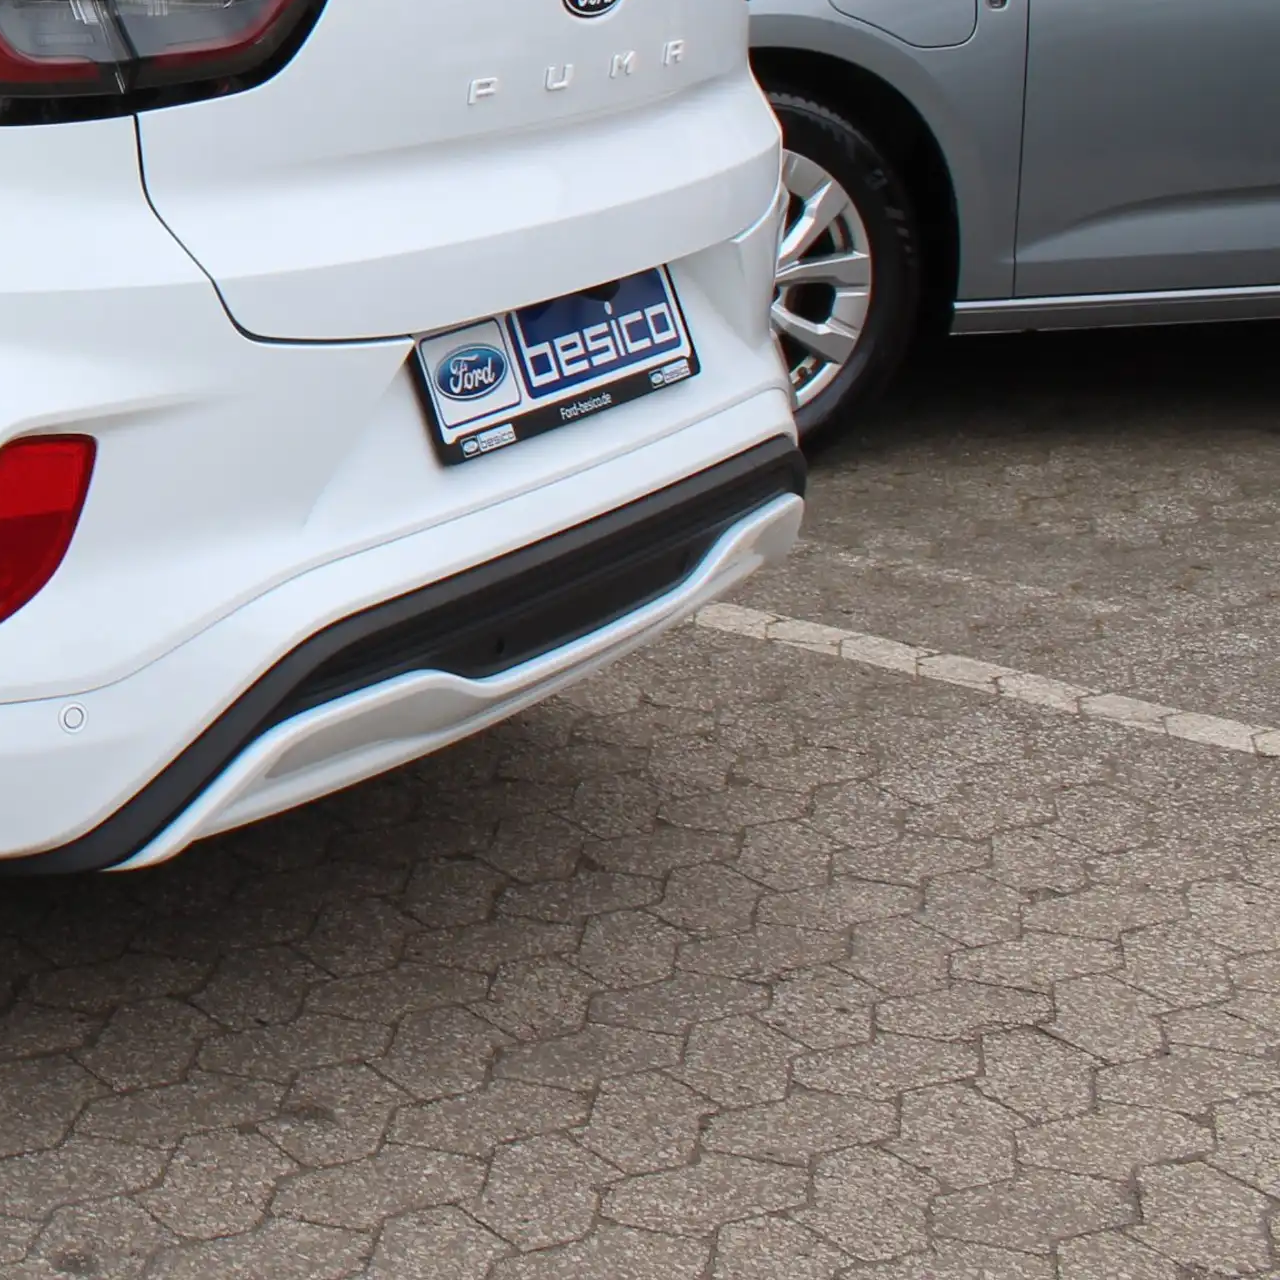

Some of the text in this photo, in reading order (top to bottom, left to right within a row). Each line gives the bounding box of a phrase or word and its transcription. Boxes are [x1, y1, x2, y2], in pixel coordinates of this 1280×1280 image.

[467, 39, 685, 105] PUMA
[514, 301, 678, 388] besico
[449, 354, 496, 394] Ford
[559, 392, 612, 421] Ford-besico.de
